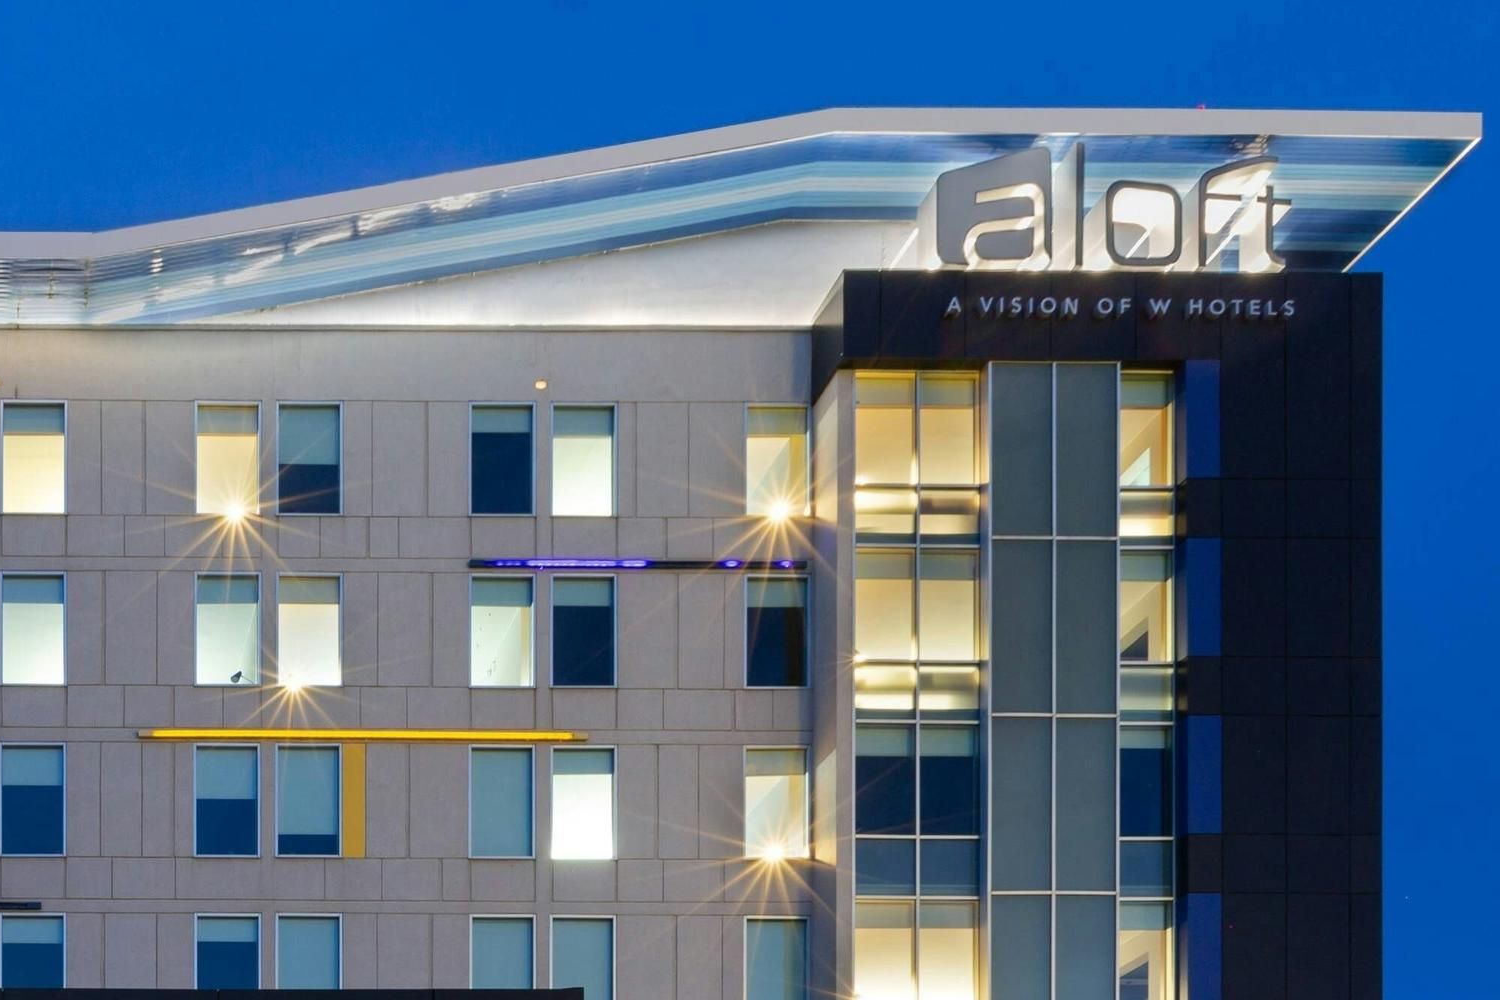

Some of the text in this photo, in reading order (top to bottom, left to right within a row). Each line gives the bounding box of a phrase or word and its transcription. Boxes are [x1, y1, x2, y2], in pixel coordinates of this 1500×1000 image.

[936, 142, 1292, 268] aloft
[946, 296, 1295, 315] A VISION OF W HOTELS
